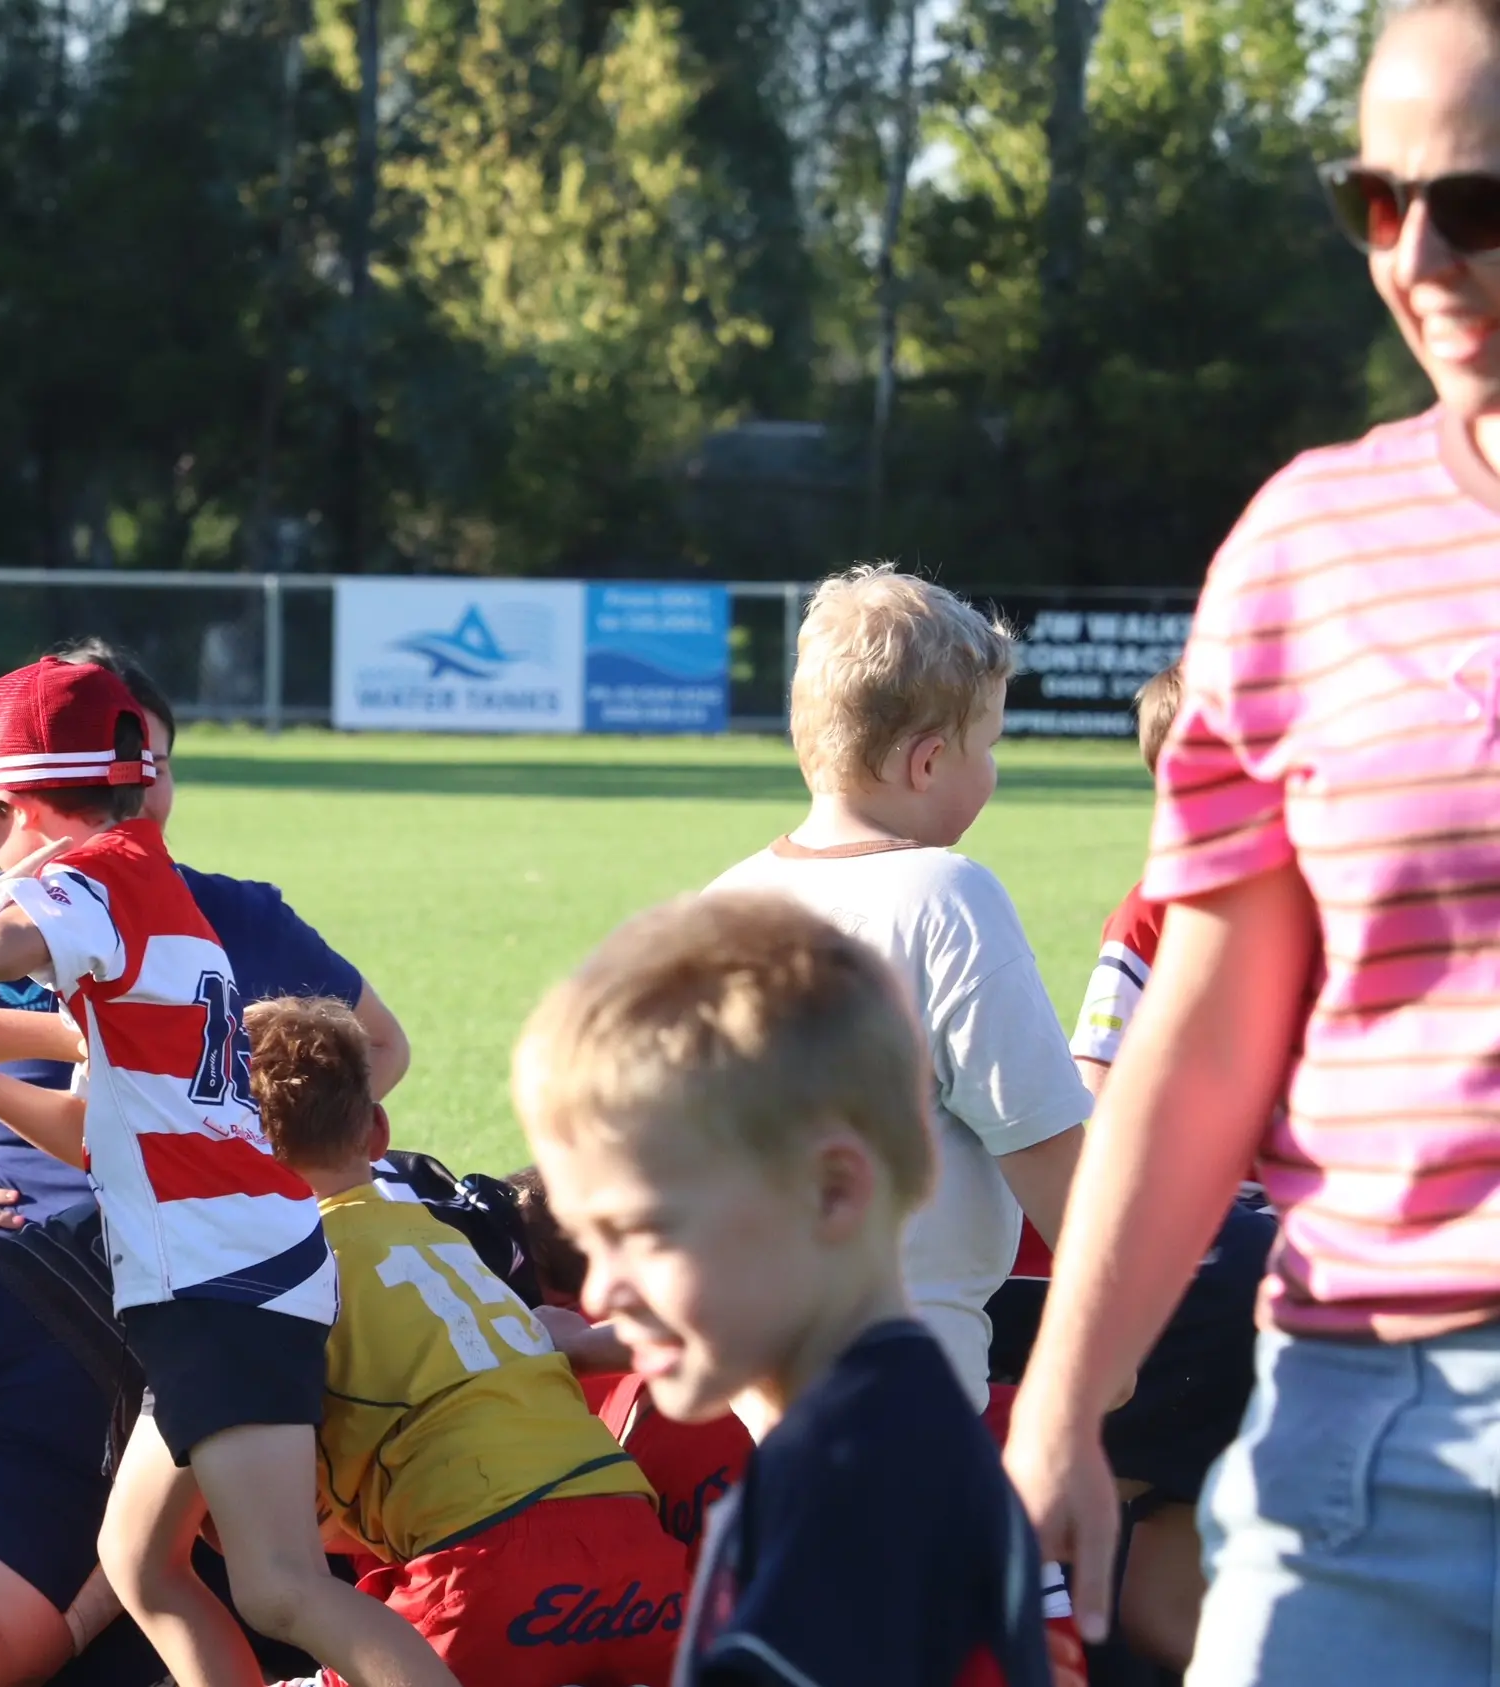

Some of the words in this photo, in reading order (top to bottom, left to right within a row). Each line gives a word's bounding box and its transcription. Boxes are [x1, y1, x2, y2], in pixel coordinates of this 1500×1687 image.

[1086, 612, 1195, 641] WALK
[356, 686, 454, 710] WATER
[466, 687, 560, 711] TANKS
[375, 1242, 556, 1373] 15
[506, 1580, 683, 1647] Elders
